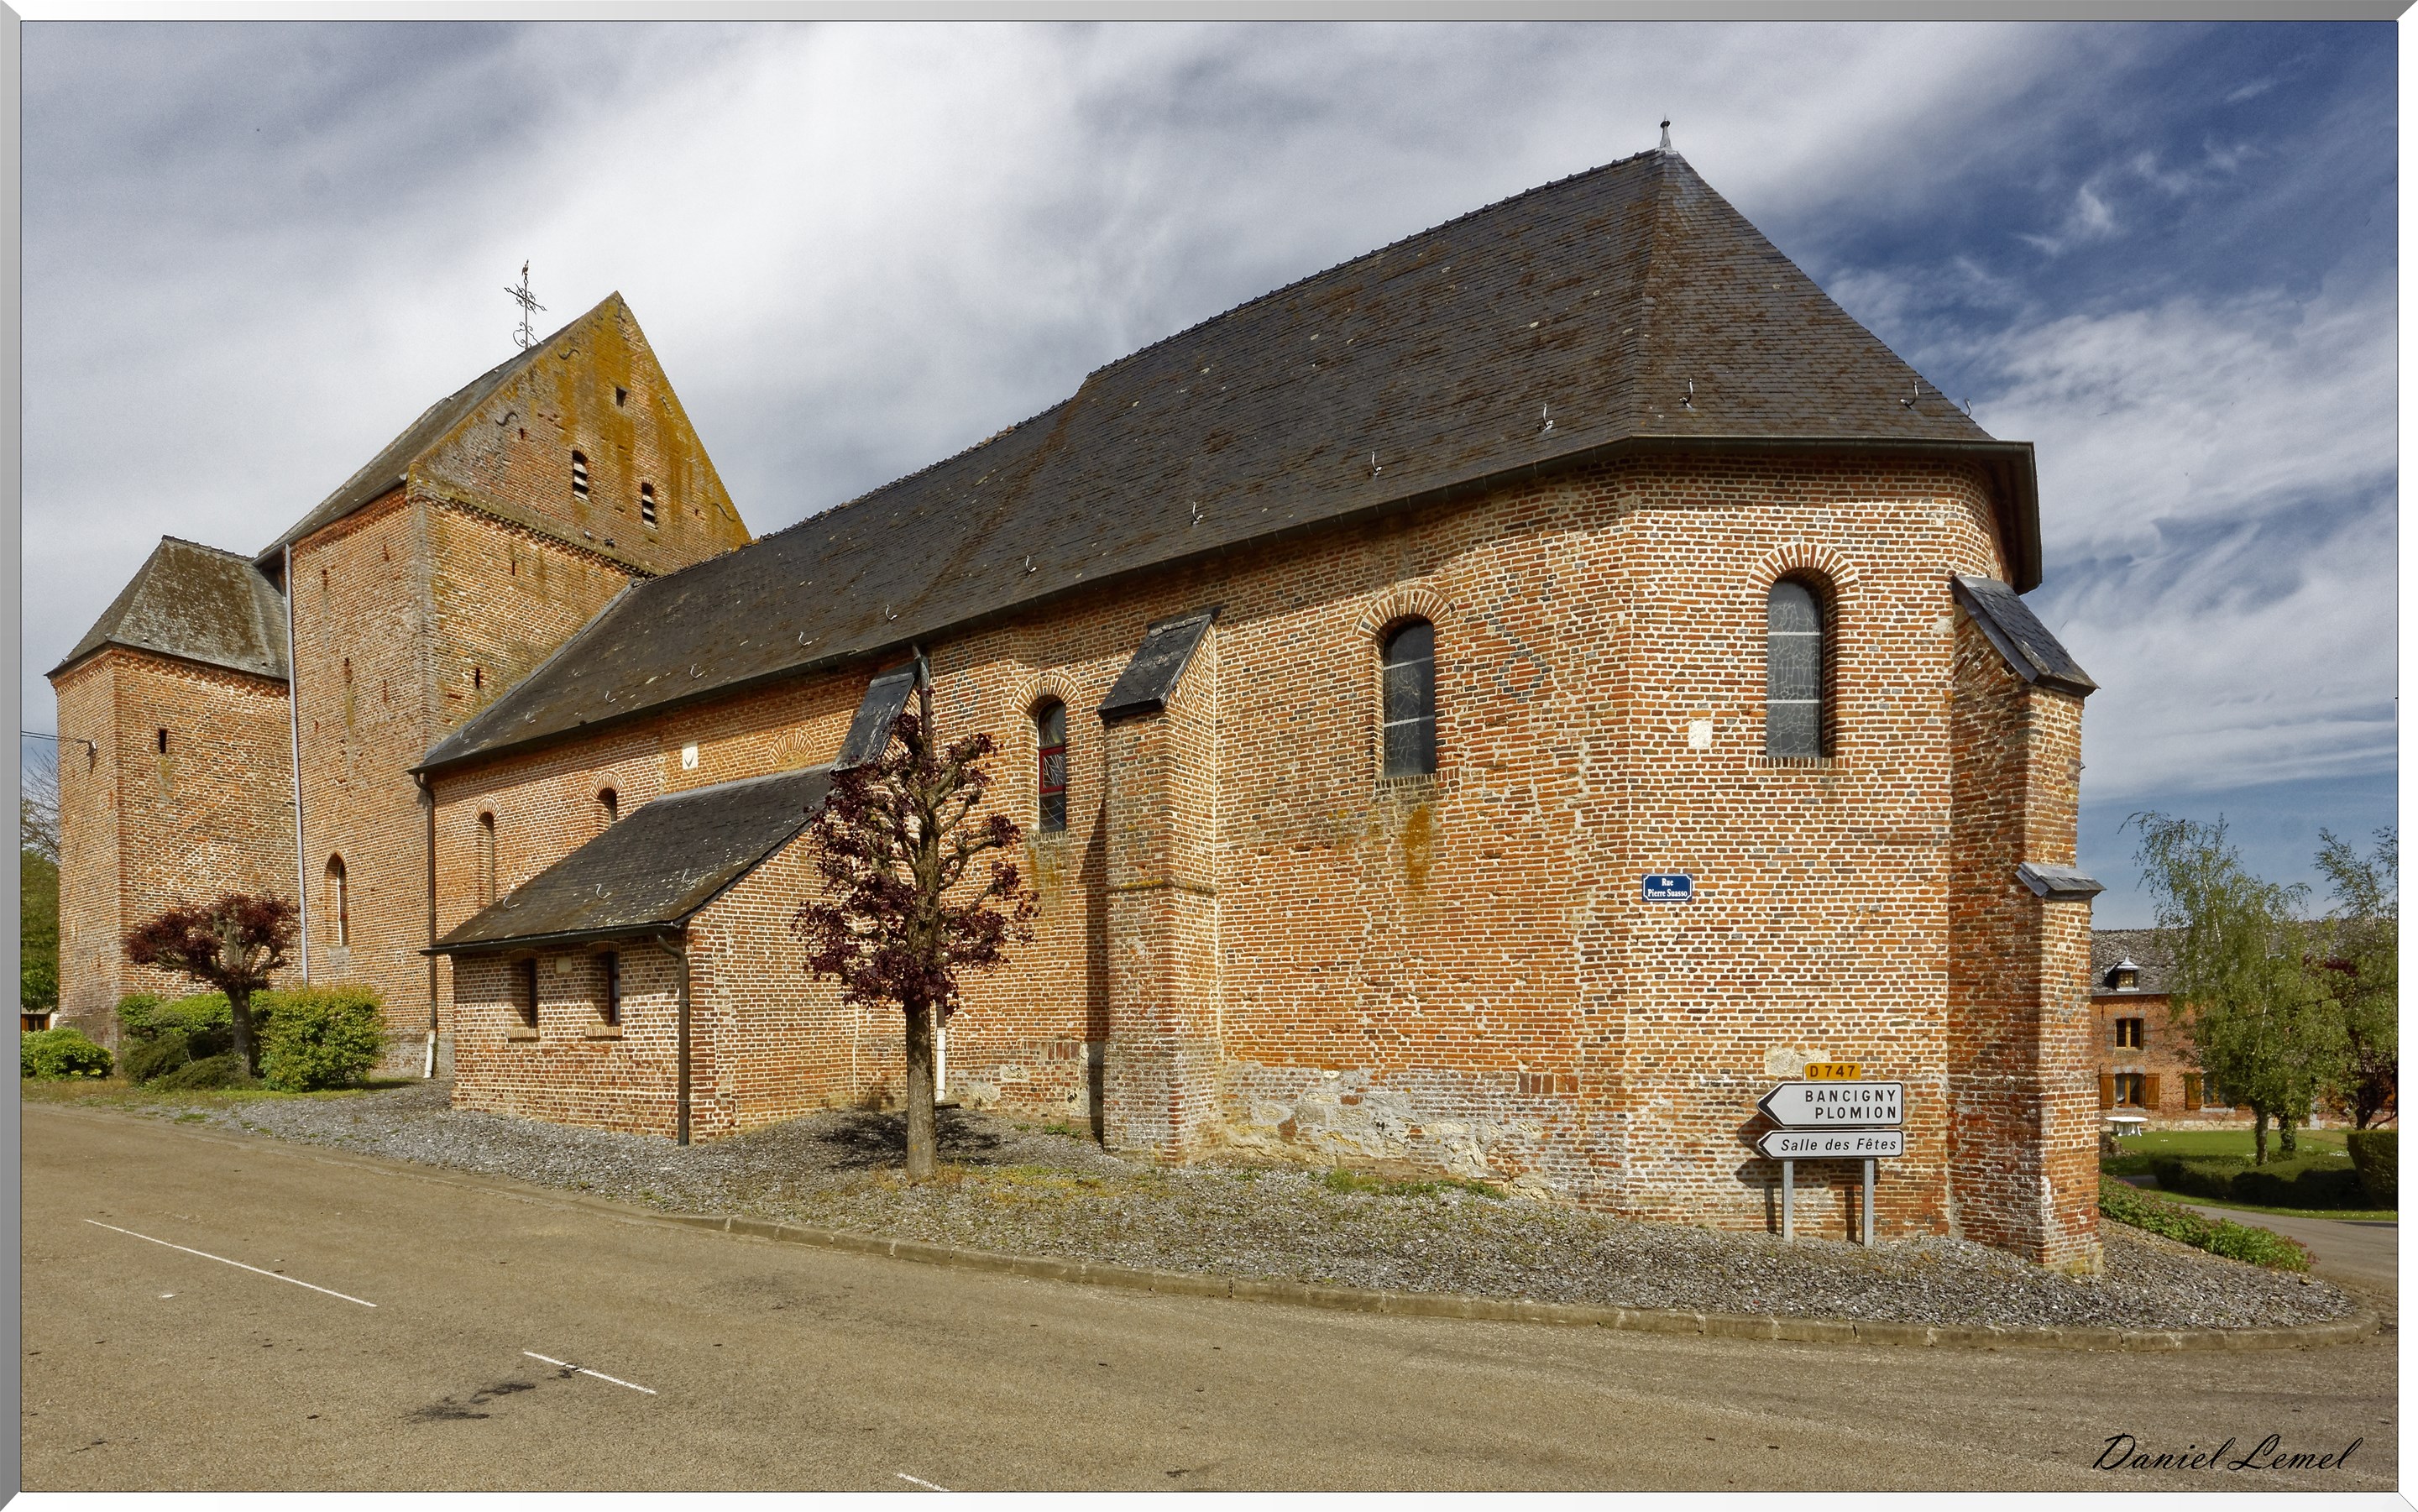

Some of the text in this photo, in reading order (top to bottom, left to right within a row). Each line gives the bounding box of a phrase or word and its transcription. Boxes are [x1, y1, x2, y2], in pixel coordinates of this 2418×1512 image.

[1662, 877, 1674, 887] Rue
[1647, 888, 1688, 897] Pierre Suasso
[1809, 1065, 1855, 1077] D 747
[1805, 1090, 1897, 1102] BANCIGNY
[1815, 1107, 1896, 1119] PLOMION
[1781, 1138, 1897, 1151] Salle des Fêtes
